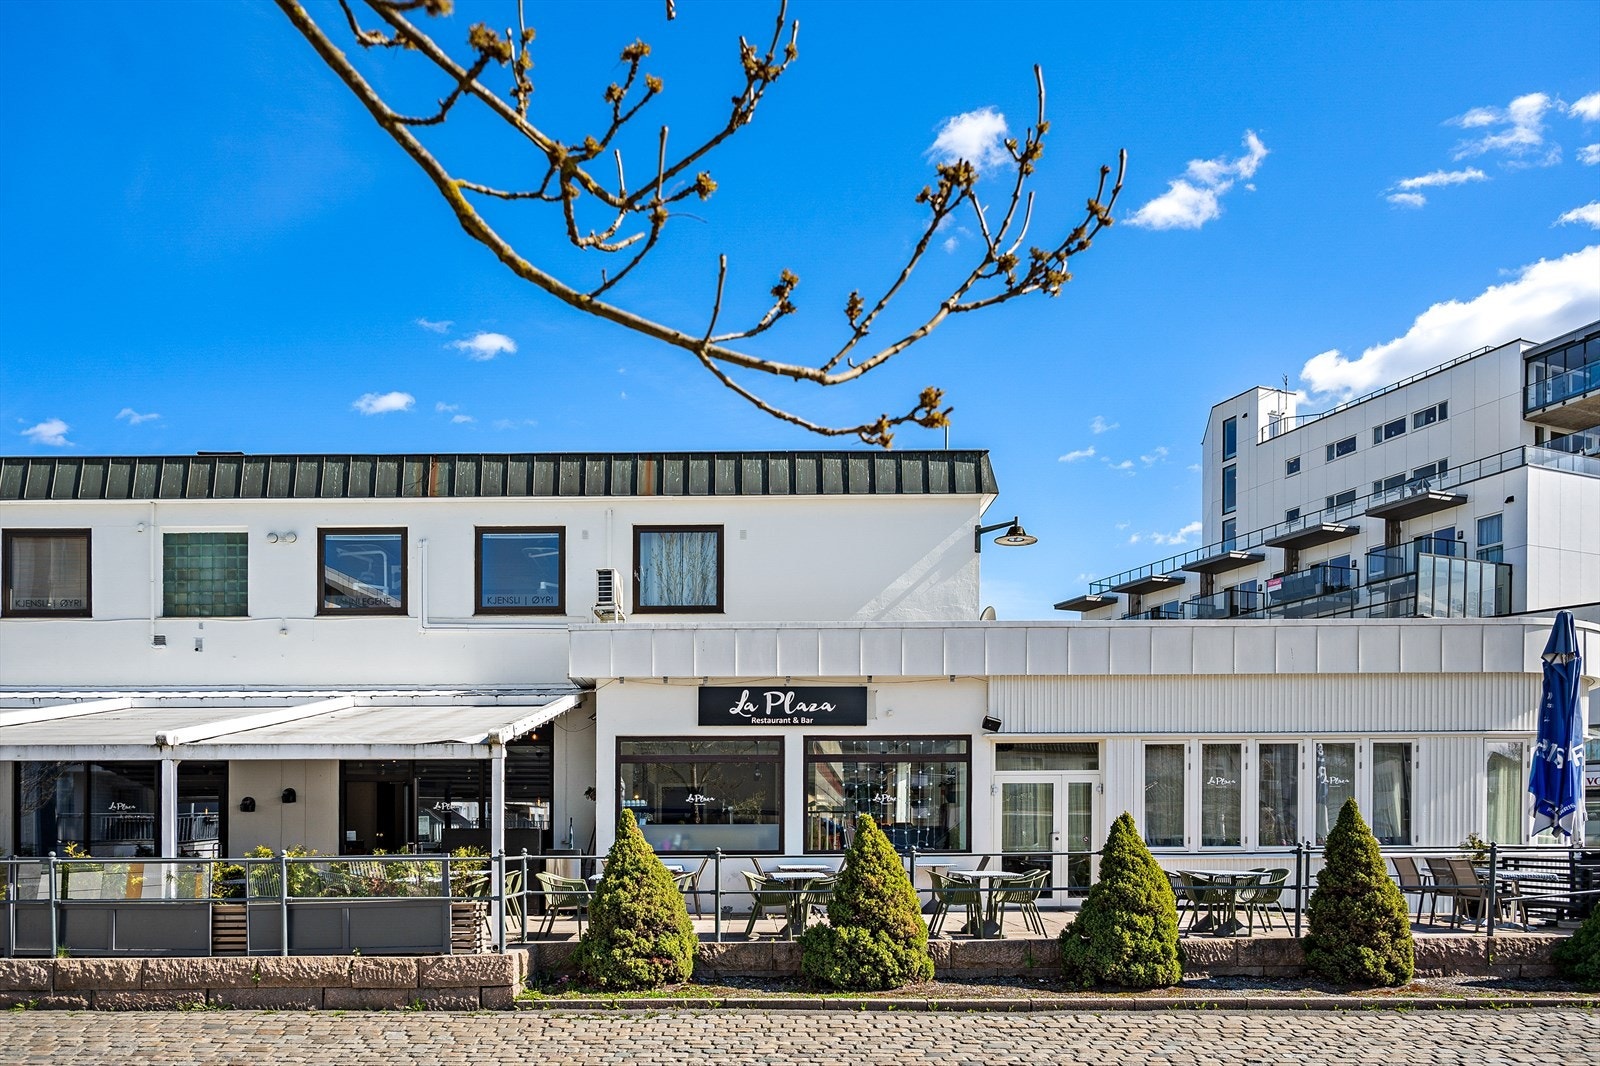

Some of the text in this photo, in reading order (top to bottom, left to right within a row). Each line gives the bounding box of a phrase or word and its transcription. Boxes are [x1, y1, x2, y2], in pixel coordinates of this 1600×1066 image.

[60, 599, 82, 608] ØYRI
[335, 597, 391, 607] ANNLEGENE
[487, 596, 521, 605] KJENSLI
[531, 596, 554, 605] ØYRI
[729, 689, 837, 718] La Plaza
[1206, 776, 1236, 786] La Plaza
[1329, 776, 1350, 785] Plaza
[685, 793, 716, 803] La Plaza
[872, 793, 882, 803] La
[108, 801, 136, 811] La Plaza
[433, 801, 441, 811] La
